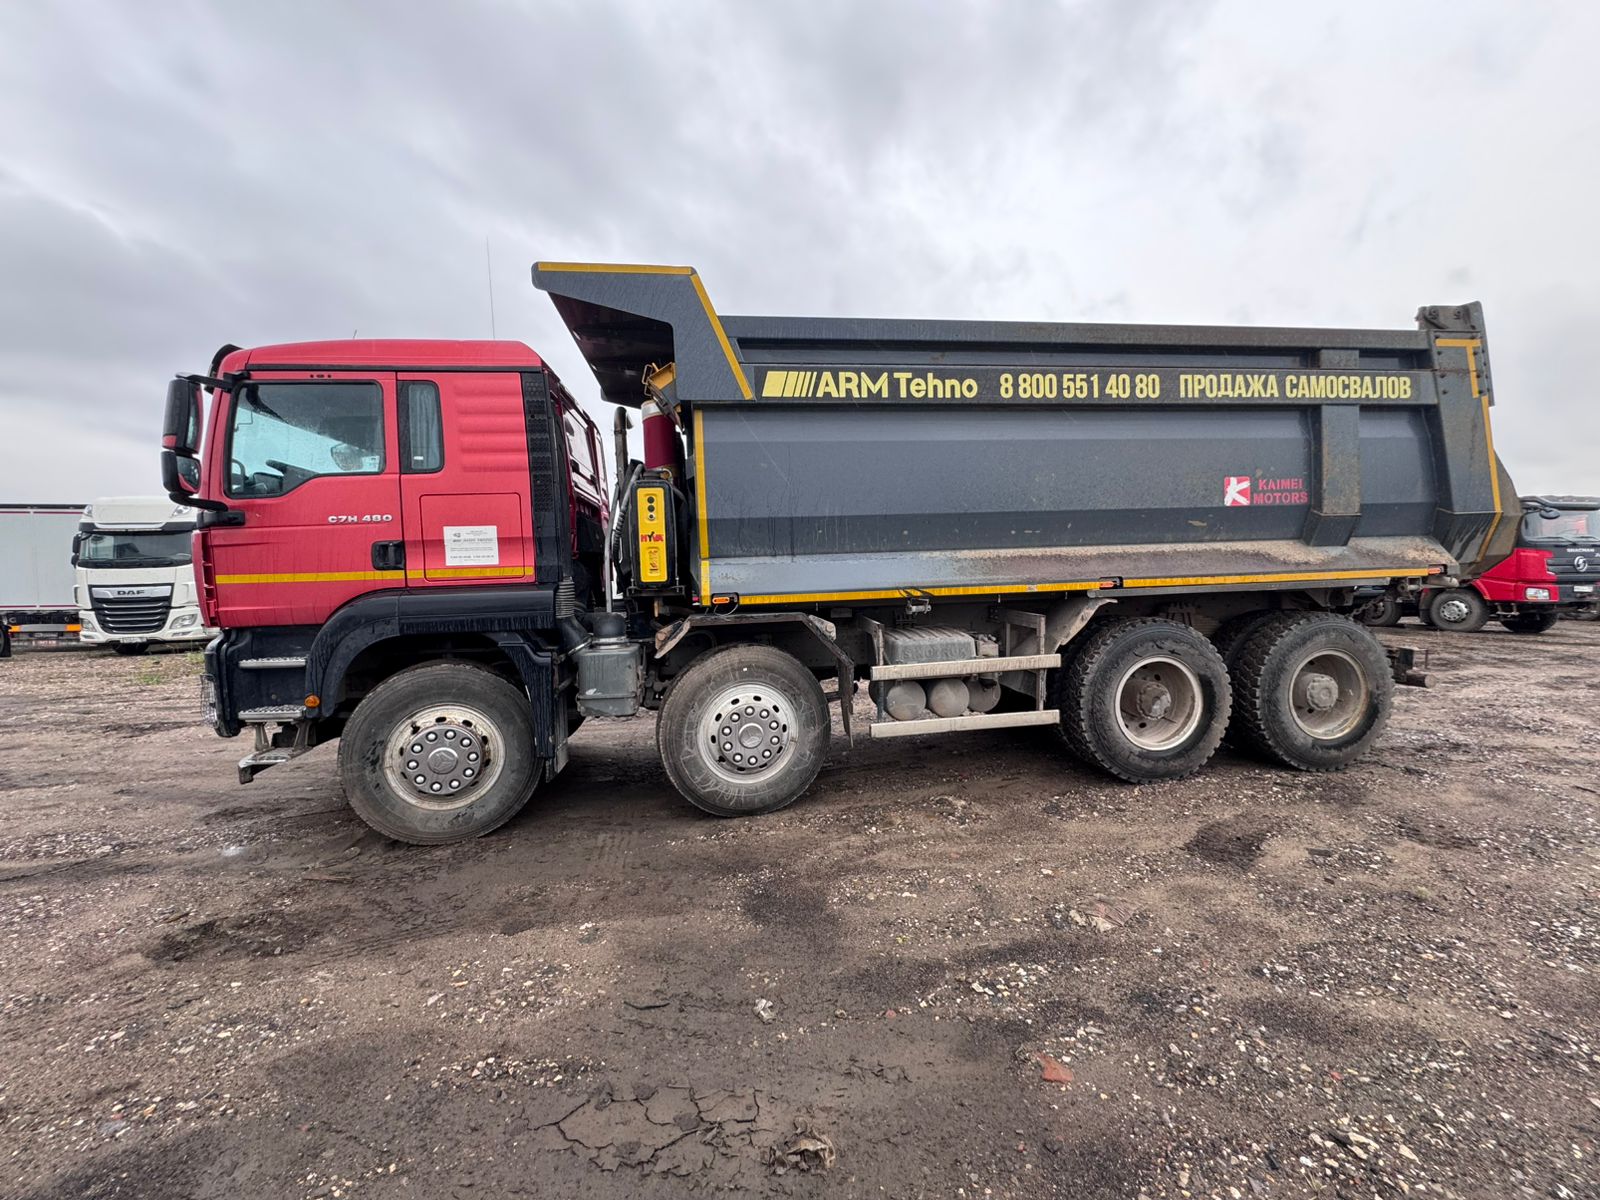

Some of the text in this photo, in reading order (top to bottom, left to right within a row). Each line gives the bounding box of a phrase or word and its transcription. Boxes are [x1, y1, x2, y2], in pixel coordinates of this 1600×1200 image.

[815, 370, 979, 399] ARM Tehno
[999, 373, 1161, 399] 8 800 551 40 80
[1179, 373, 1412, 400] ПРОДАЖА САМОСВАЛОВ
[1257, 478, 1304, 491] KAIMEI
[1253, 491, 1309, 505] MOTORS
[327, 514, 393, 523] C7H 480
